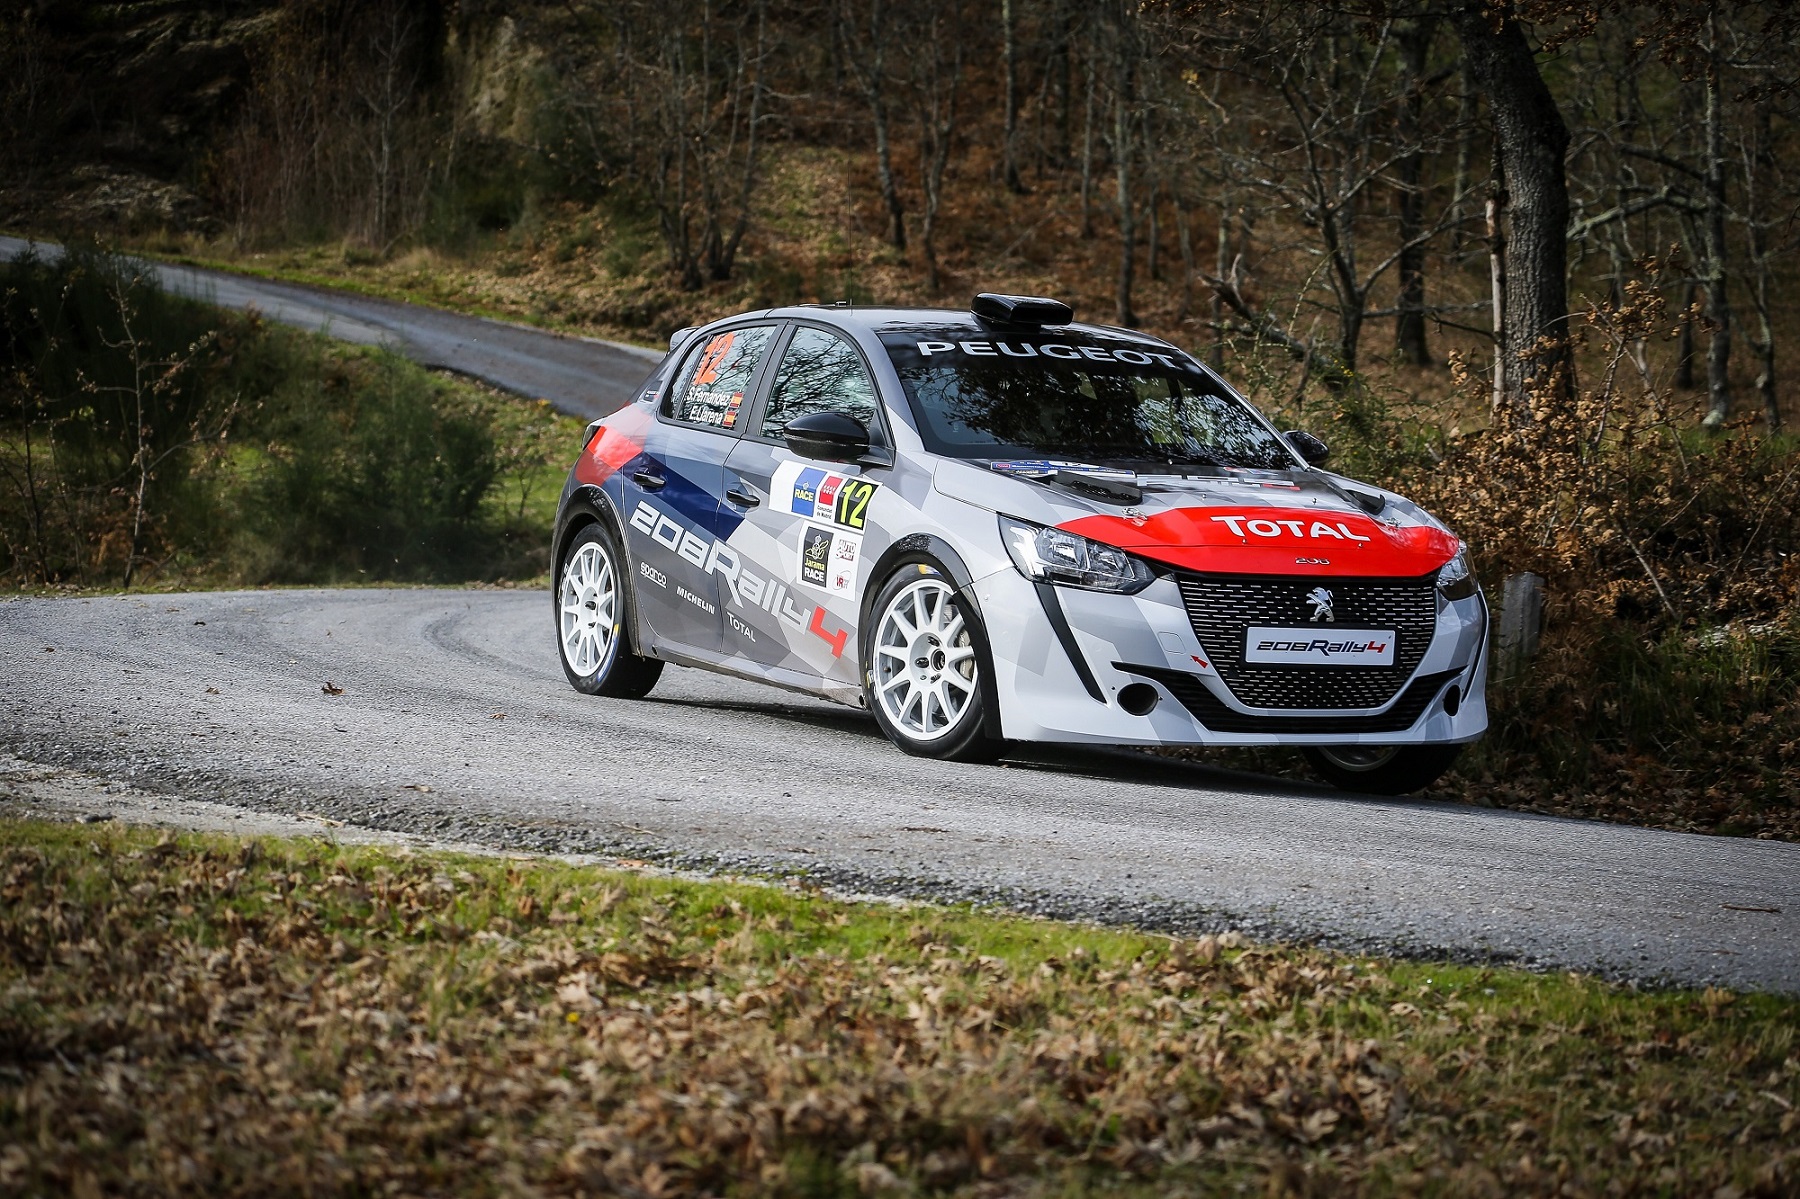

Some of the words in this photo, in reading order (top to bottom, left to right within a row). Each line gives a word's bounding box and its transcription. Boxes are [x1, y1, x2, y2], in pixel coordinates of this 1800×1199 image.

[693, 332, 734, 385] 12
[916, 341, 1182, 369] PEUGEOT
[794, 488, 816, 502] RACE
[841, 481, 873, 528] 12
[1210, 515, 1371, 542] TOTAL
[640, 561, 667, 588] sparco
[804, 557, 825, 570] Jarama
[804, 567, 825, 582] RACE
[676, 586, 715, 615] MICHELIN
[726, 611, 756, 643] TOTAL
